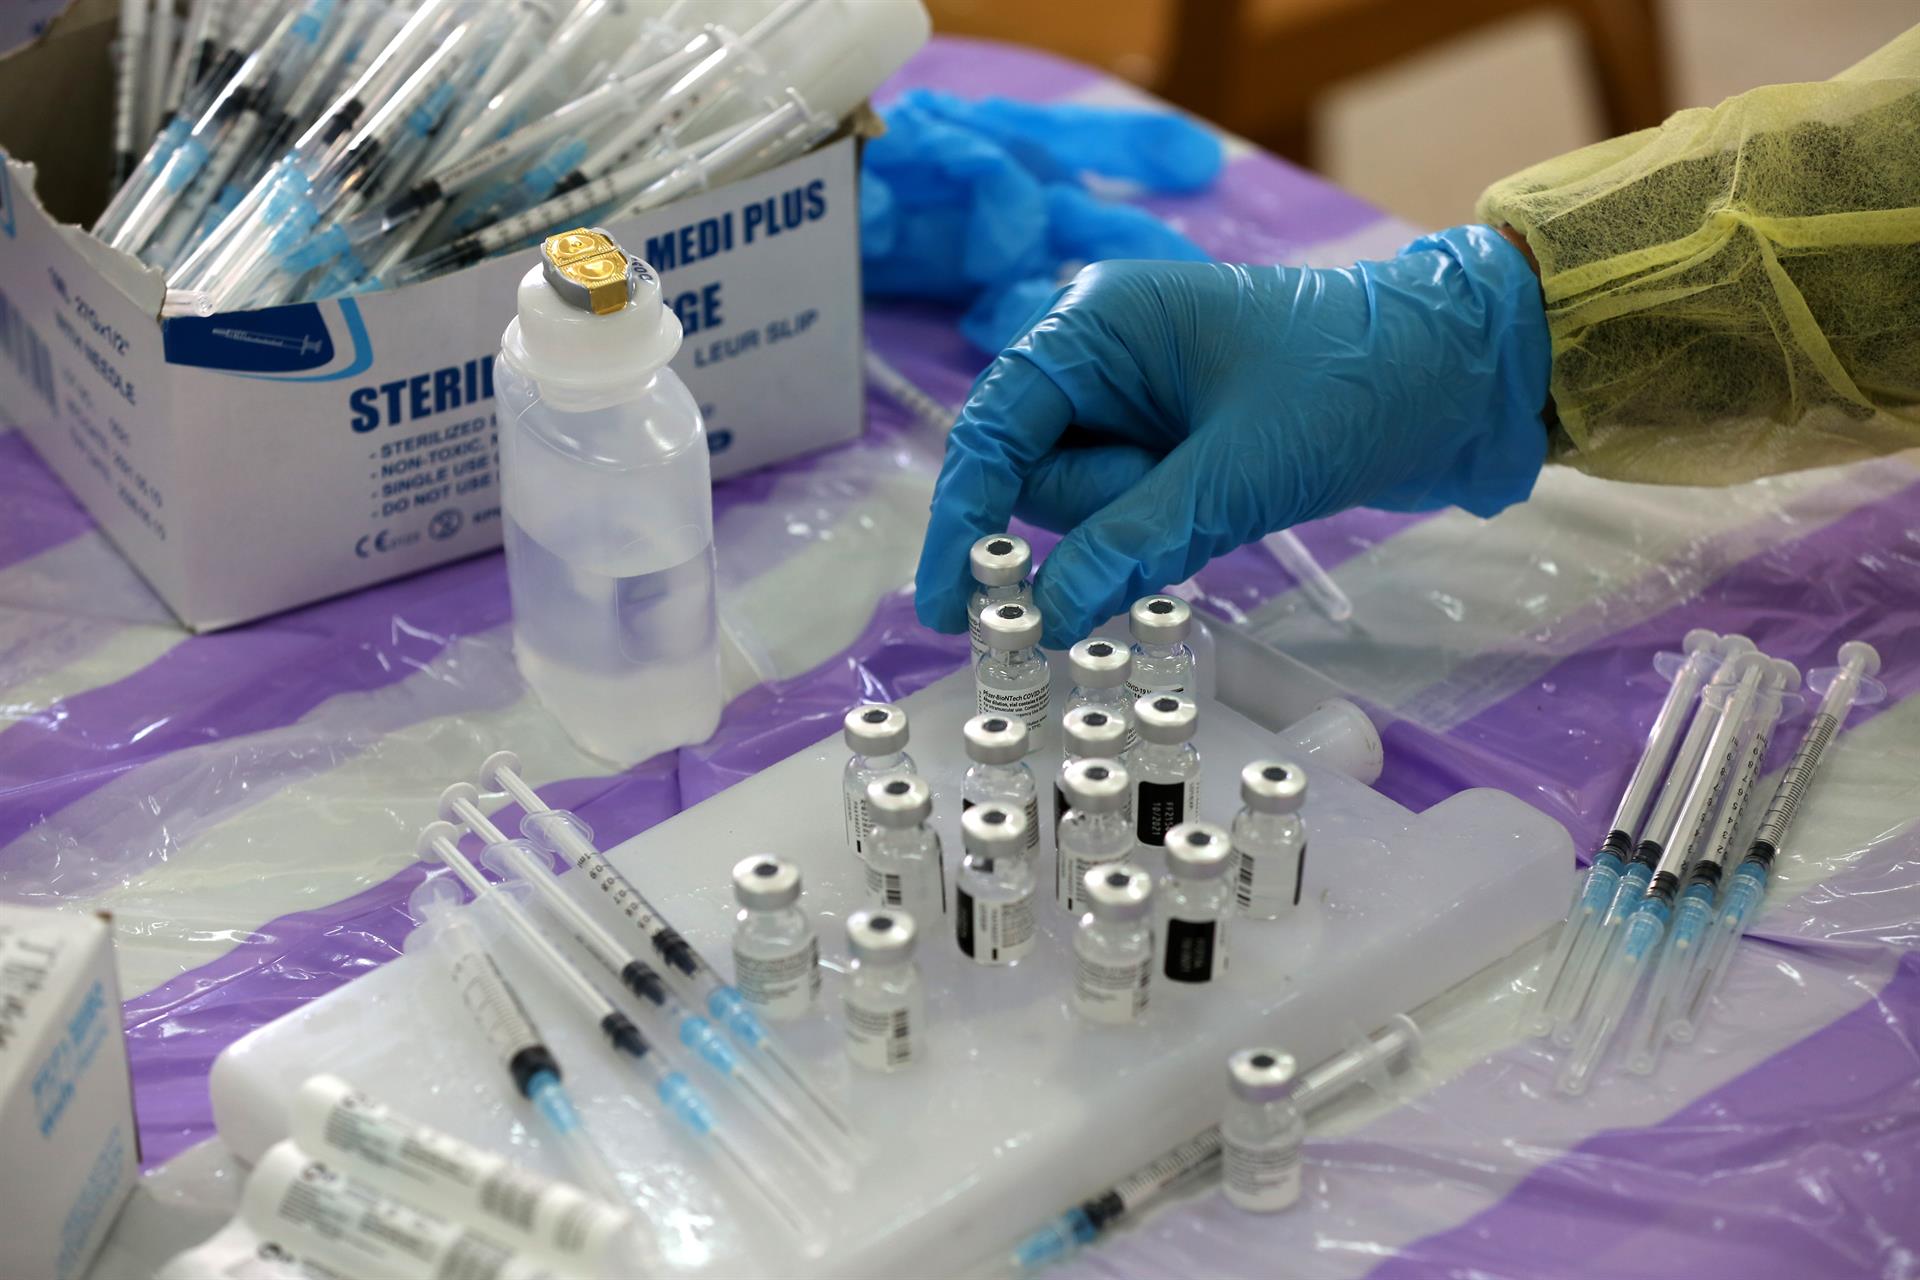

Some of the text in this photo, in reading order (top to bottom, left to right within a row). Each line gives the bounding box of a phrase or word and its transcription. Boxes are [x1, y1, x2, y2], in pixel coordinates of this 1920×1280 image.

[645, 210, 734, 274] MEDI
[742, 179, 827, 244] PLUS
[693, 308, 819, 368] LEUR SLIP
[381, 416, 486, 459] STERILIZED
[382, 455, 489, 497] SINGLE USE
[382, 474, 491, 518] DO NOT USE
